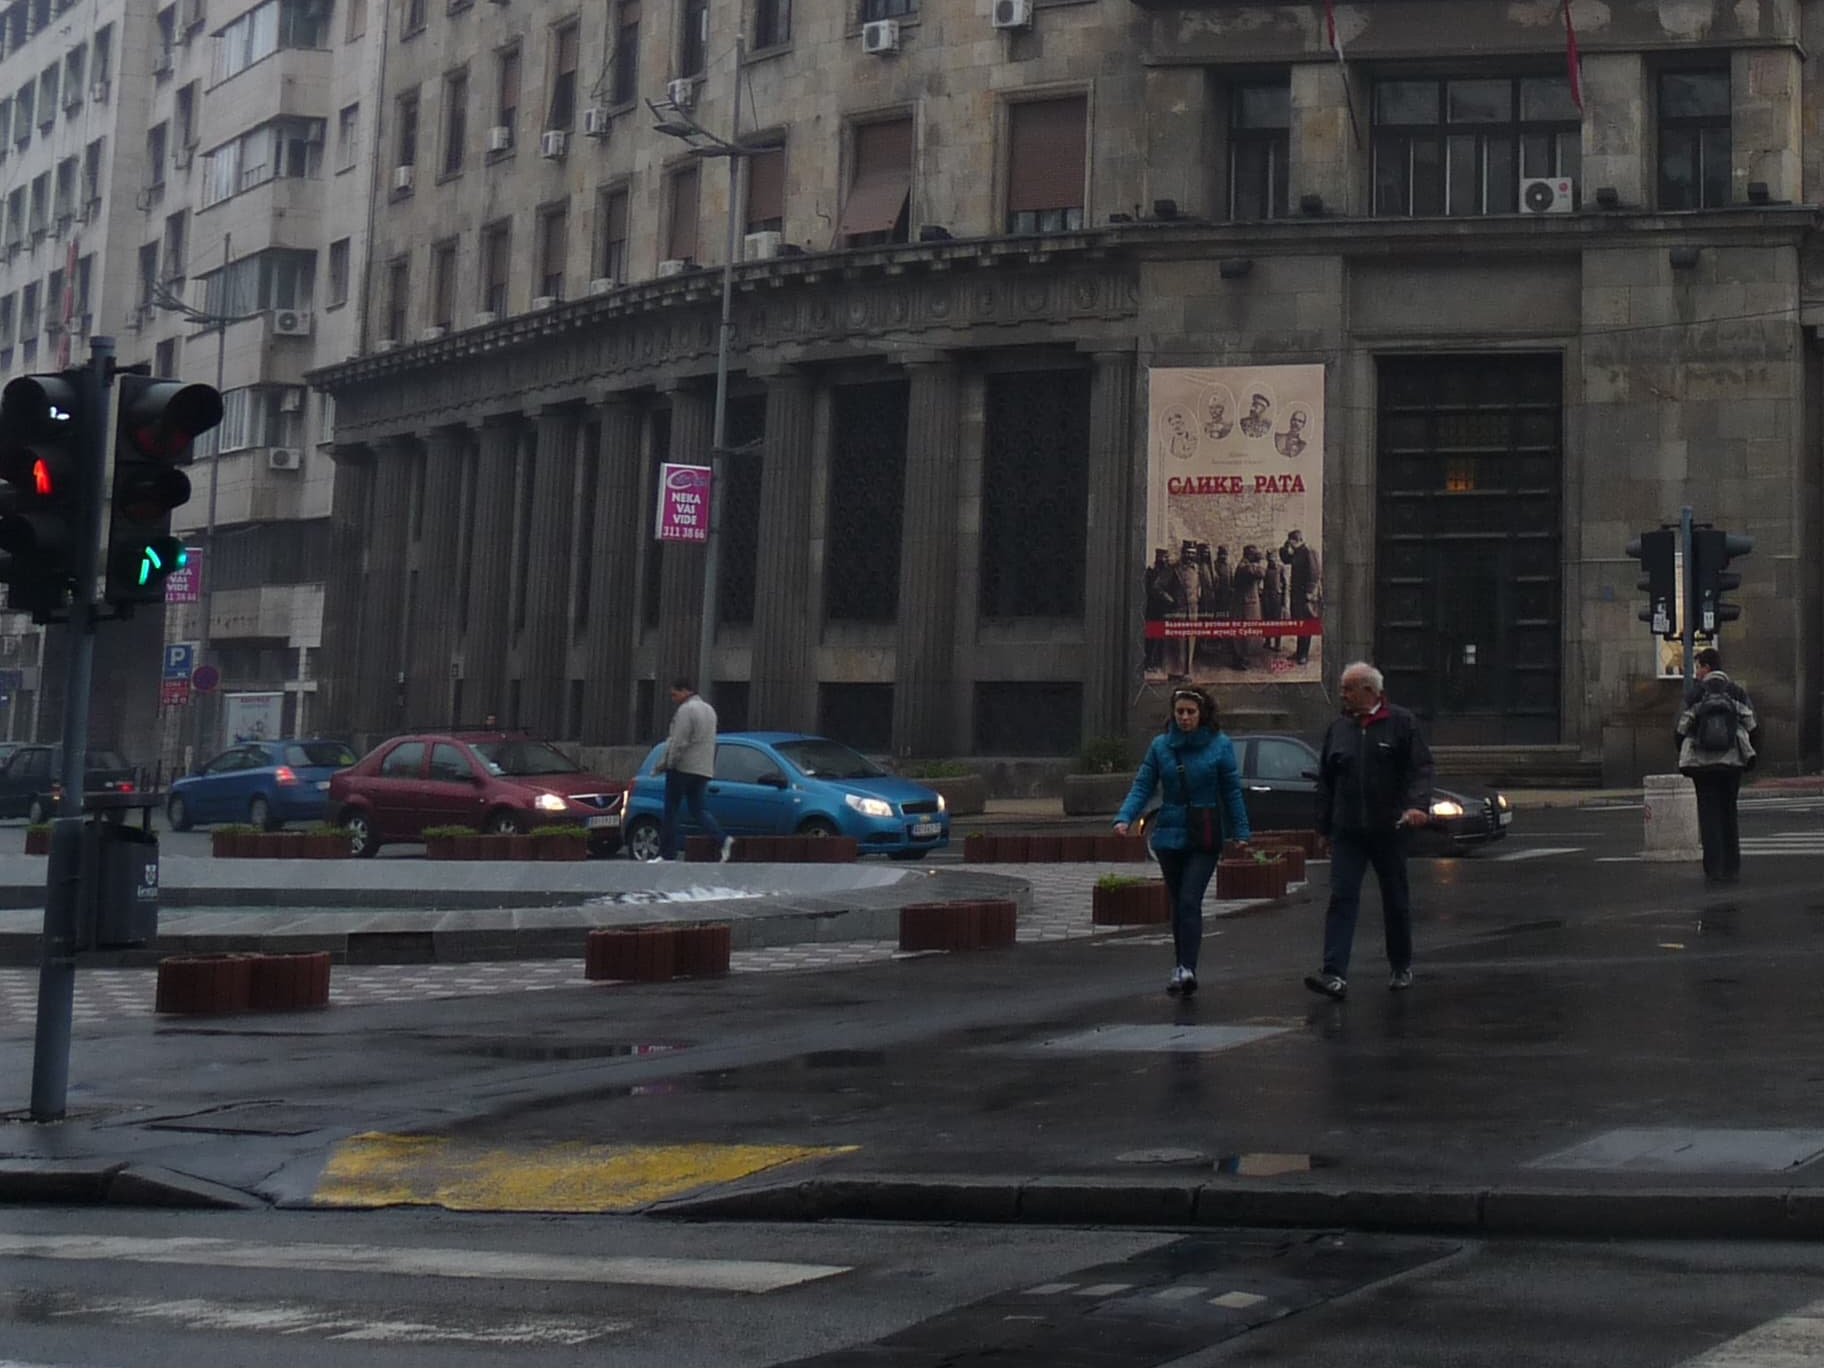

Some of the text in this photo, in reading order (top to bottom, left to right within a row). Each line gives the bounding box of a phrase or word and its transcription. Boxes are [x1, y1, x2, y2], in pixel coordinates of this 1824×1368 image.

[1168, 474, 1305, 495] СЛИКЕ РАТА
[671, 492, 701, 504] NEKA
[672, 514, 697, 525] VIDE
[170, 647, 186, 667] P
